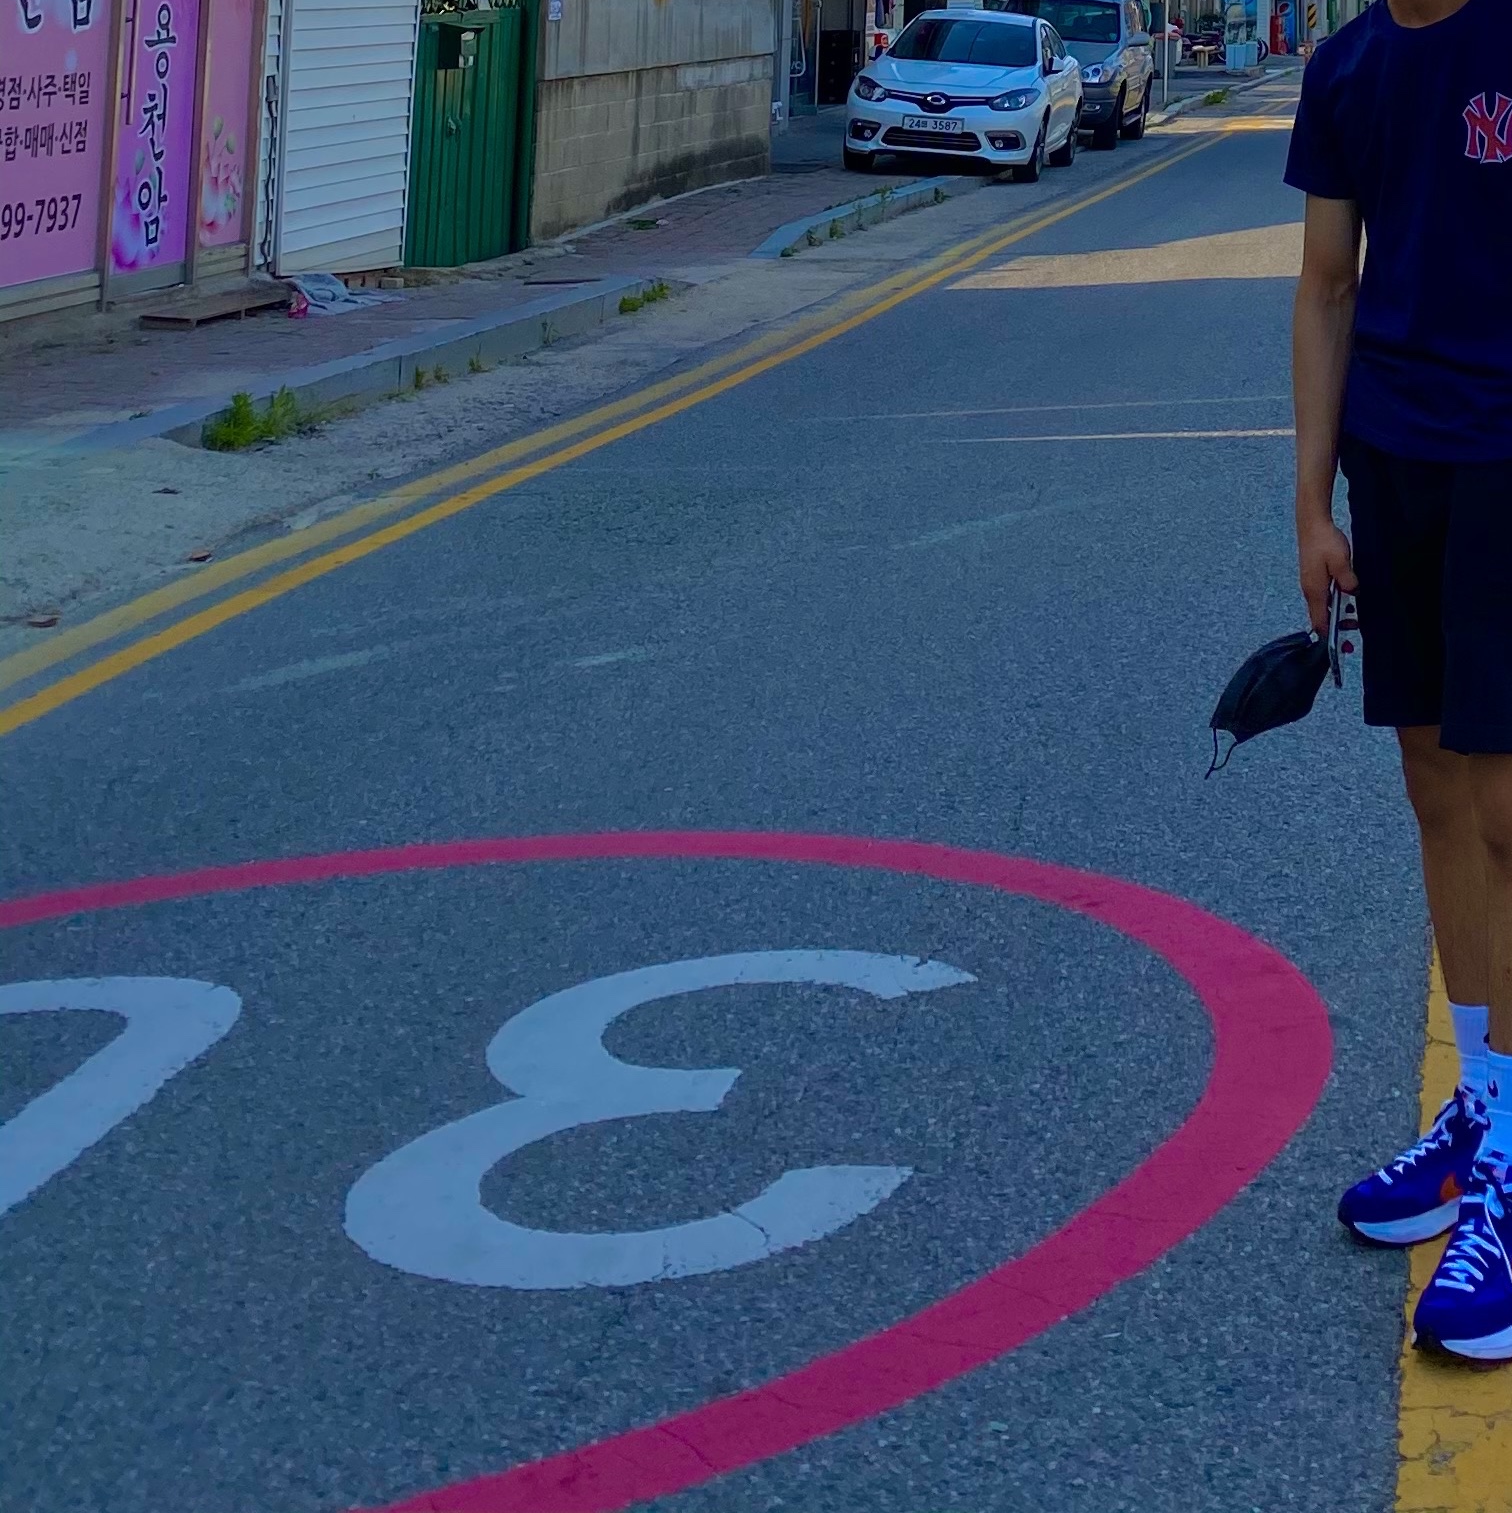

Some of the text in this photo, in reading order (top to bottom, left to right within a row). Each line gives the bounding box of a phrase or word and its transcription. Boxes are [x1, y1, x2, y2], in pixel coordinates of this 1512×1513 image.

[0, 120, 88, 162] 합·매매·신점
[138, 2, 177, 247] 용천암
[931, 120, 958, 131] 3587
[1, 193, 82, 239] 99-7937
